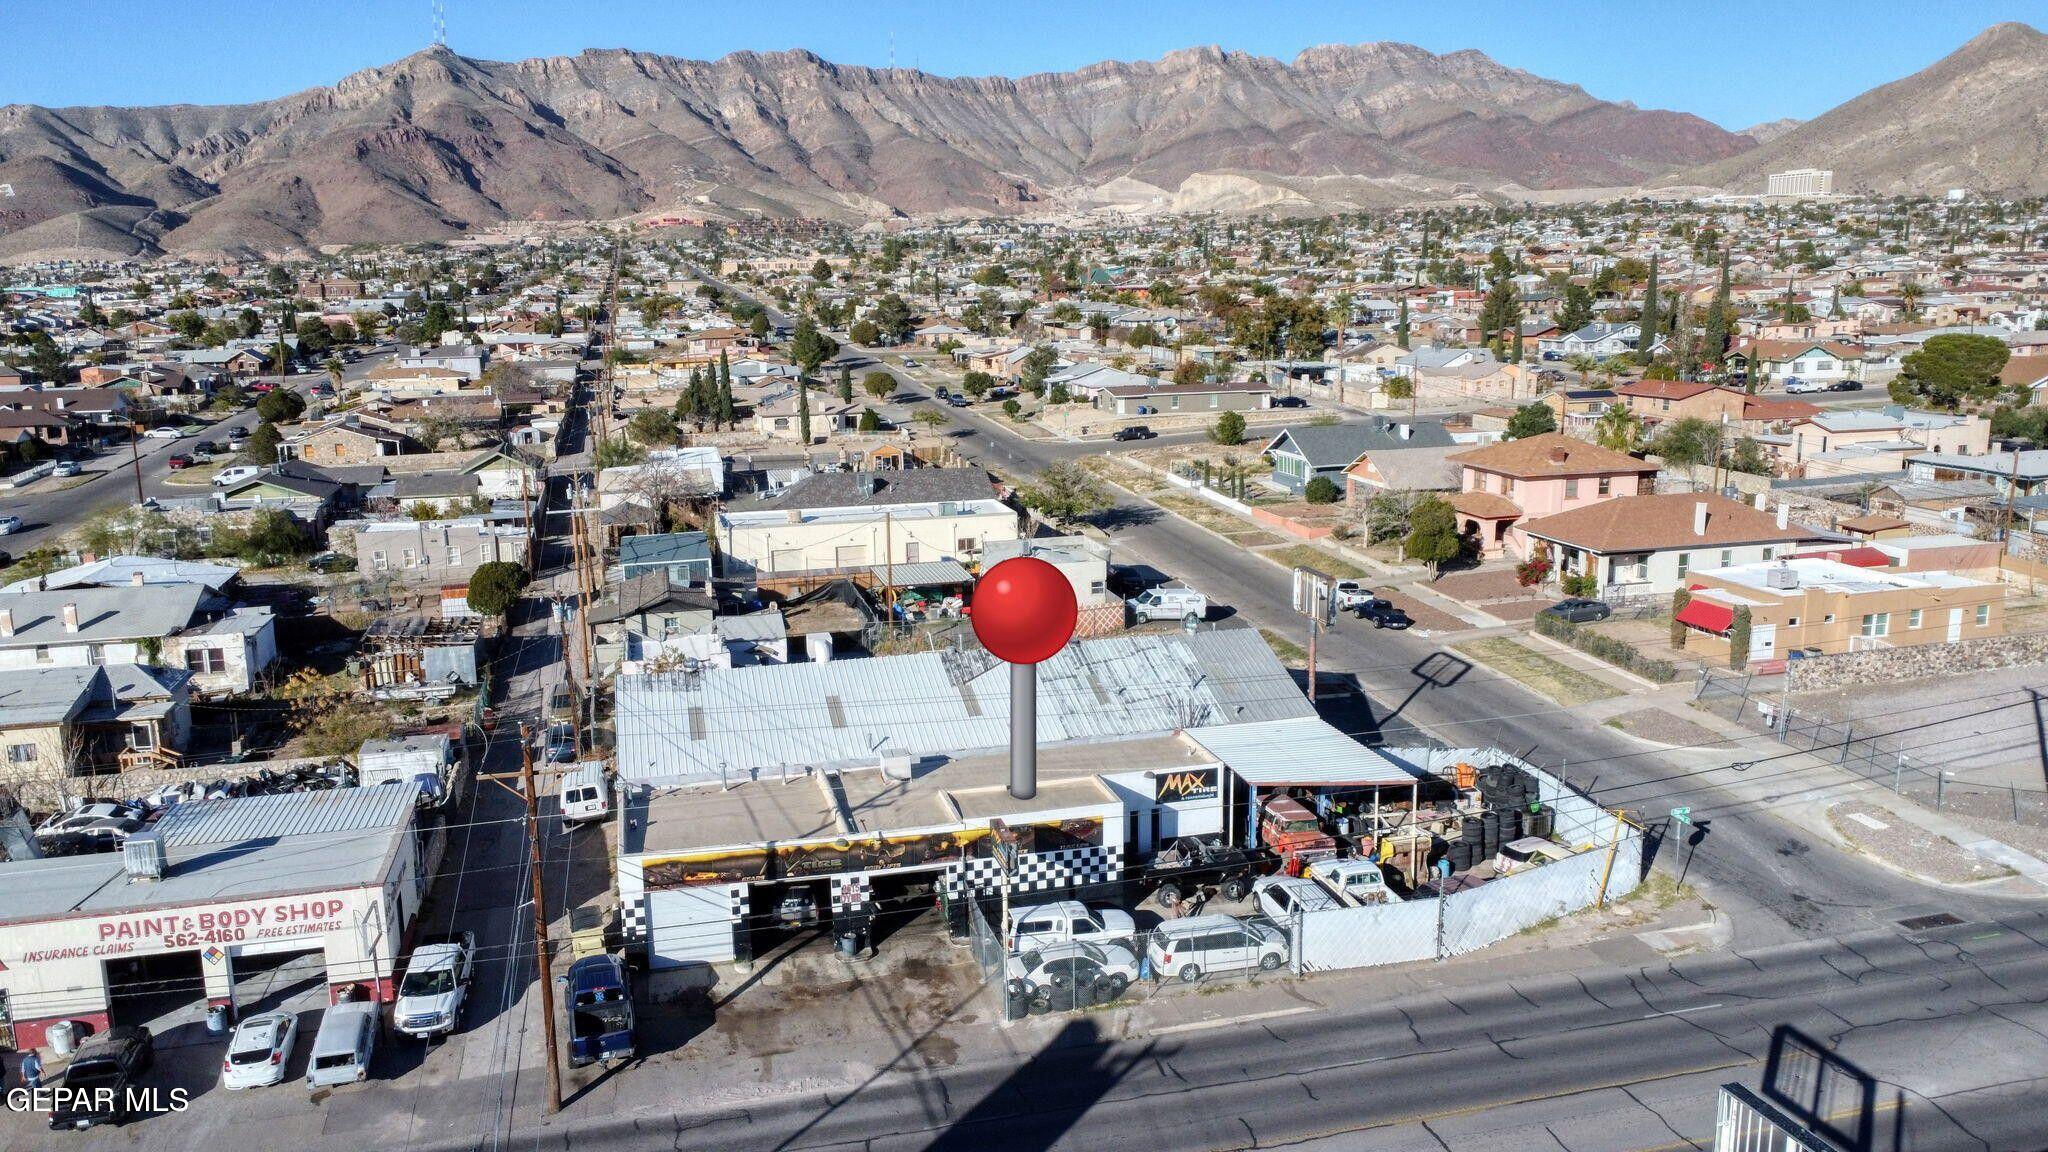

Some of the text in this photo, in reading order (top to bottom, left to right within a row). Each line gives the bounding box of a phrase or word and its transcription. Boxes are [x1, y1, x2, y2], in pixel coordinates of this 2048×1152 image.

[1157, 772, 1207, 799] MAX
[98, 900, 344, 941] PAINT & BODY SHOP
[256, 921, 342, 938] FREE ESTIMATES
[163, 928, 246, 948] 562-4160
[23, 942, 135, 963] INSURANCE CLAIMS
